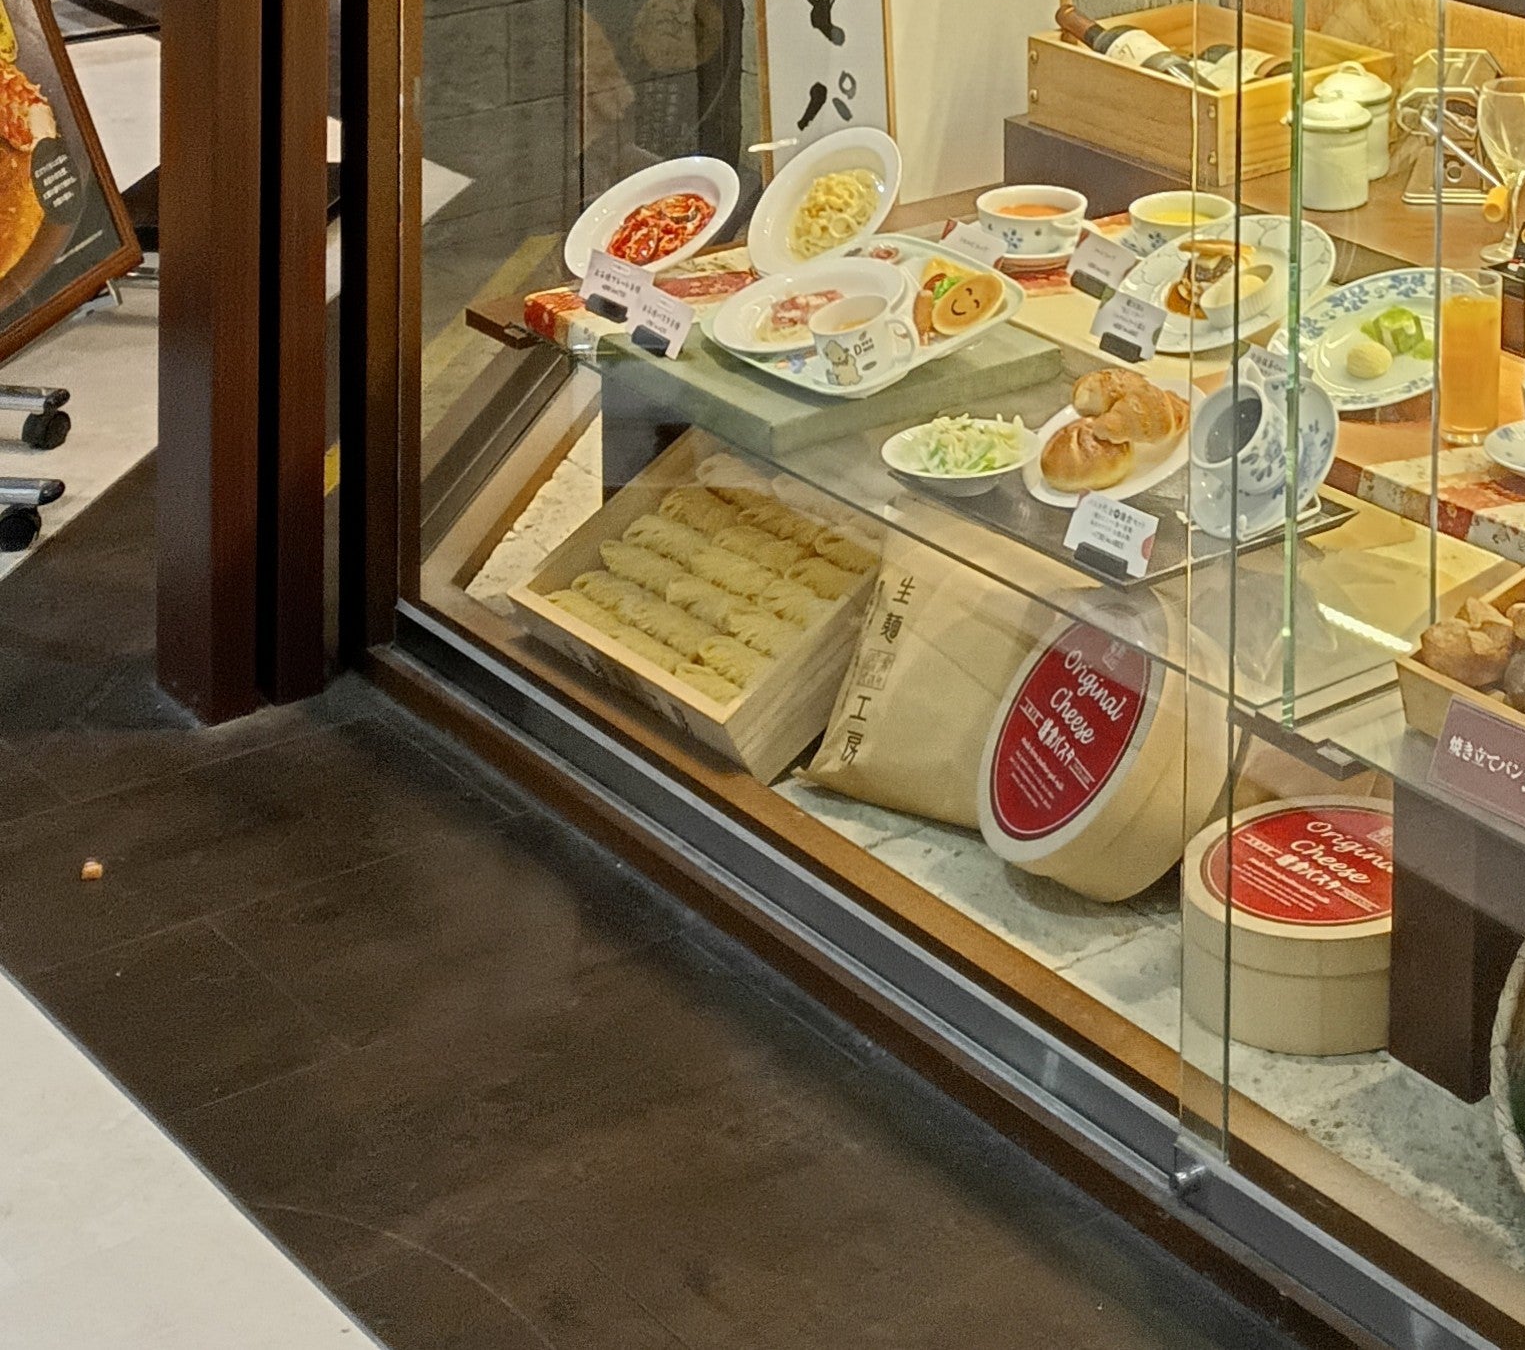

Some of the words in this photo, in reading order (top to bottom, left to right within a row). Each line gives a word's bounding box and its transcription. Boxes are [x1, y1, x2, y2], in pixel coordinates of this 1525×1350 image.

[879, 575, 916, 644] 生麺
[1049, 686, 1096, 745] Cheese
[1063, 649, 1128, 723] Original
[840, 694, 872, 765] 工房
[1449, 734, 1524, 780] 焼き立てパン
[1290, 839, 1372, 884] Cheese
[1306, 820, 1394, 874] Origina
